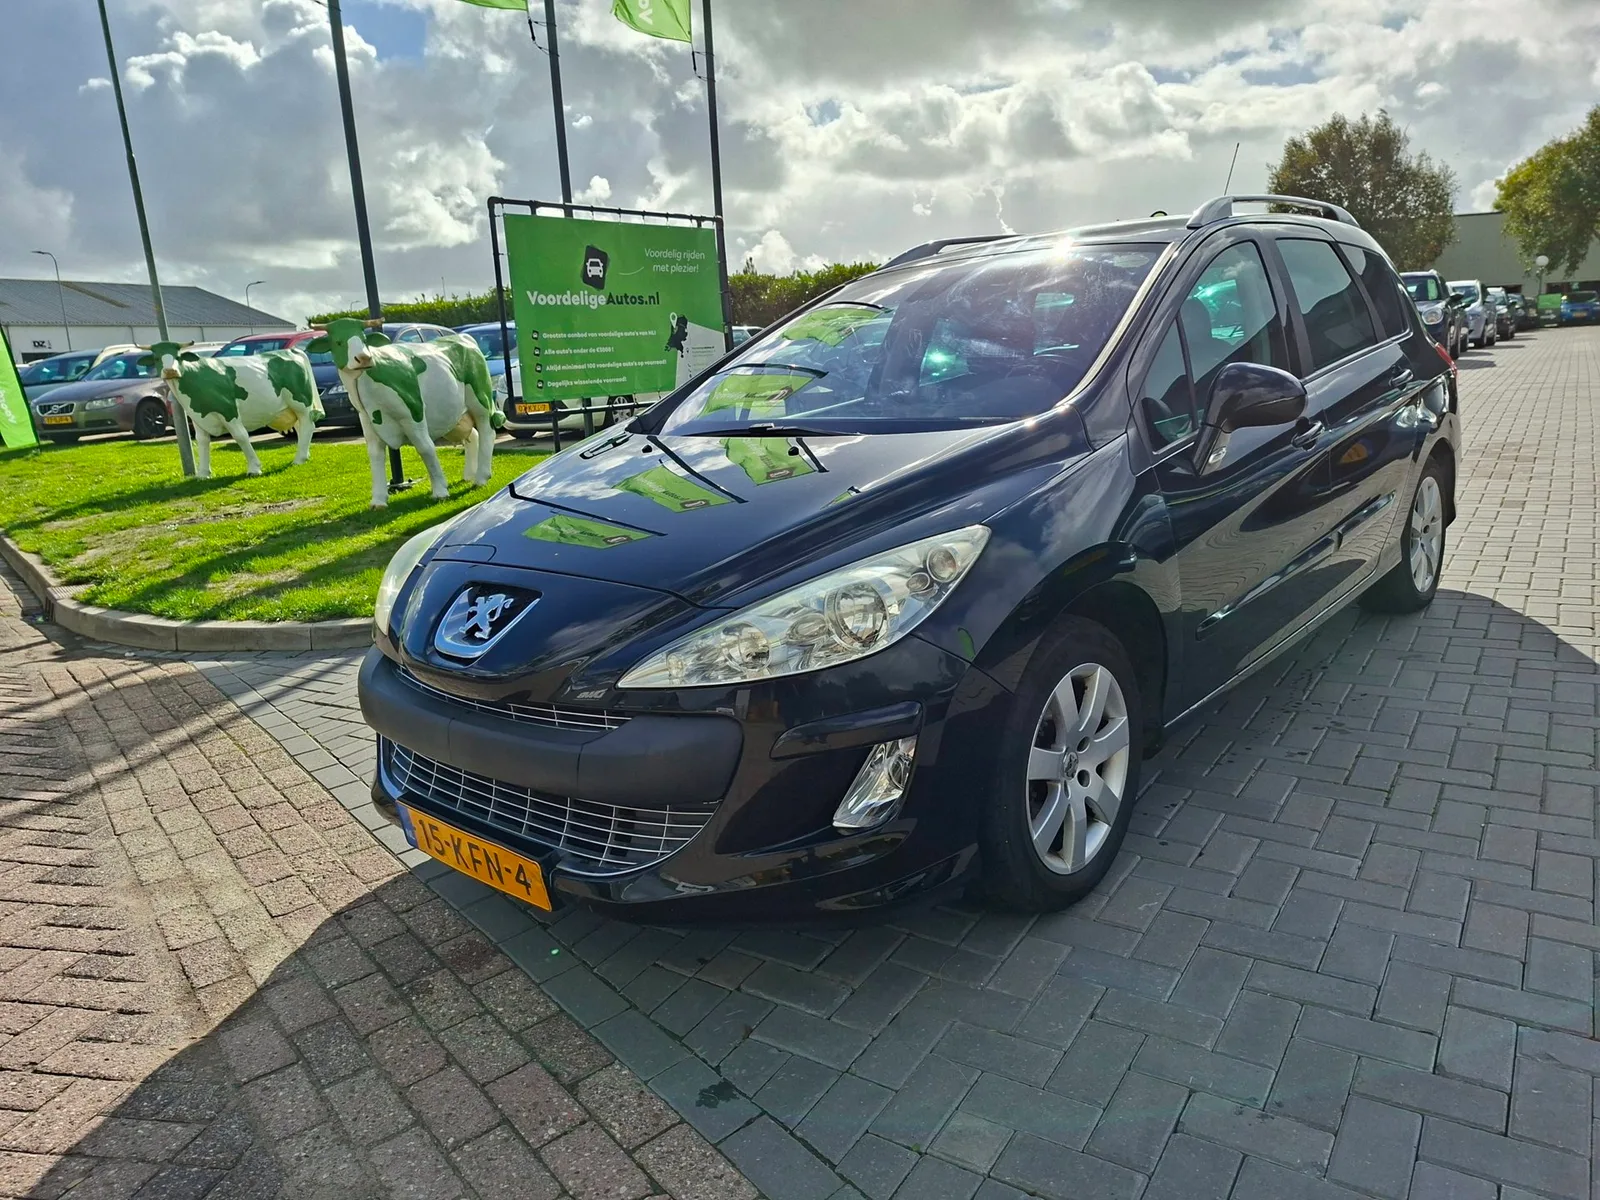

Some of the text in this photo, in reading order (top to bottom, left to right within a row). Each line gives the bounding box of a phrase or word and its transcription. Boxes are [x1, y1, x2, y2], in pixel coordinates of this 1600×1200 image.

[644, 248, 705, 262] Voordelig rijden
[652, 264, 699, 274] met plezier!
[526, 290, 660, 309] VoordeligeAutos.nl
[598, 331, 623, 339] voordelige
[556, 347, 573, 355] auto's
[546, 364, 561, 372] Altijd
[562, 363, 586, 371] minimaal
[596, 361, 622, 369] voordelige
[622, 360, 637, 368] auto's
[547, 376, 627, 388] Dagelijks wisselende voorraad!
[418, 819, 533, 896] 15-KFN-4
